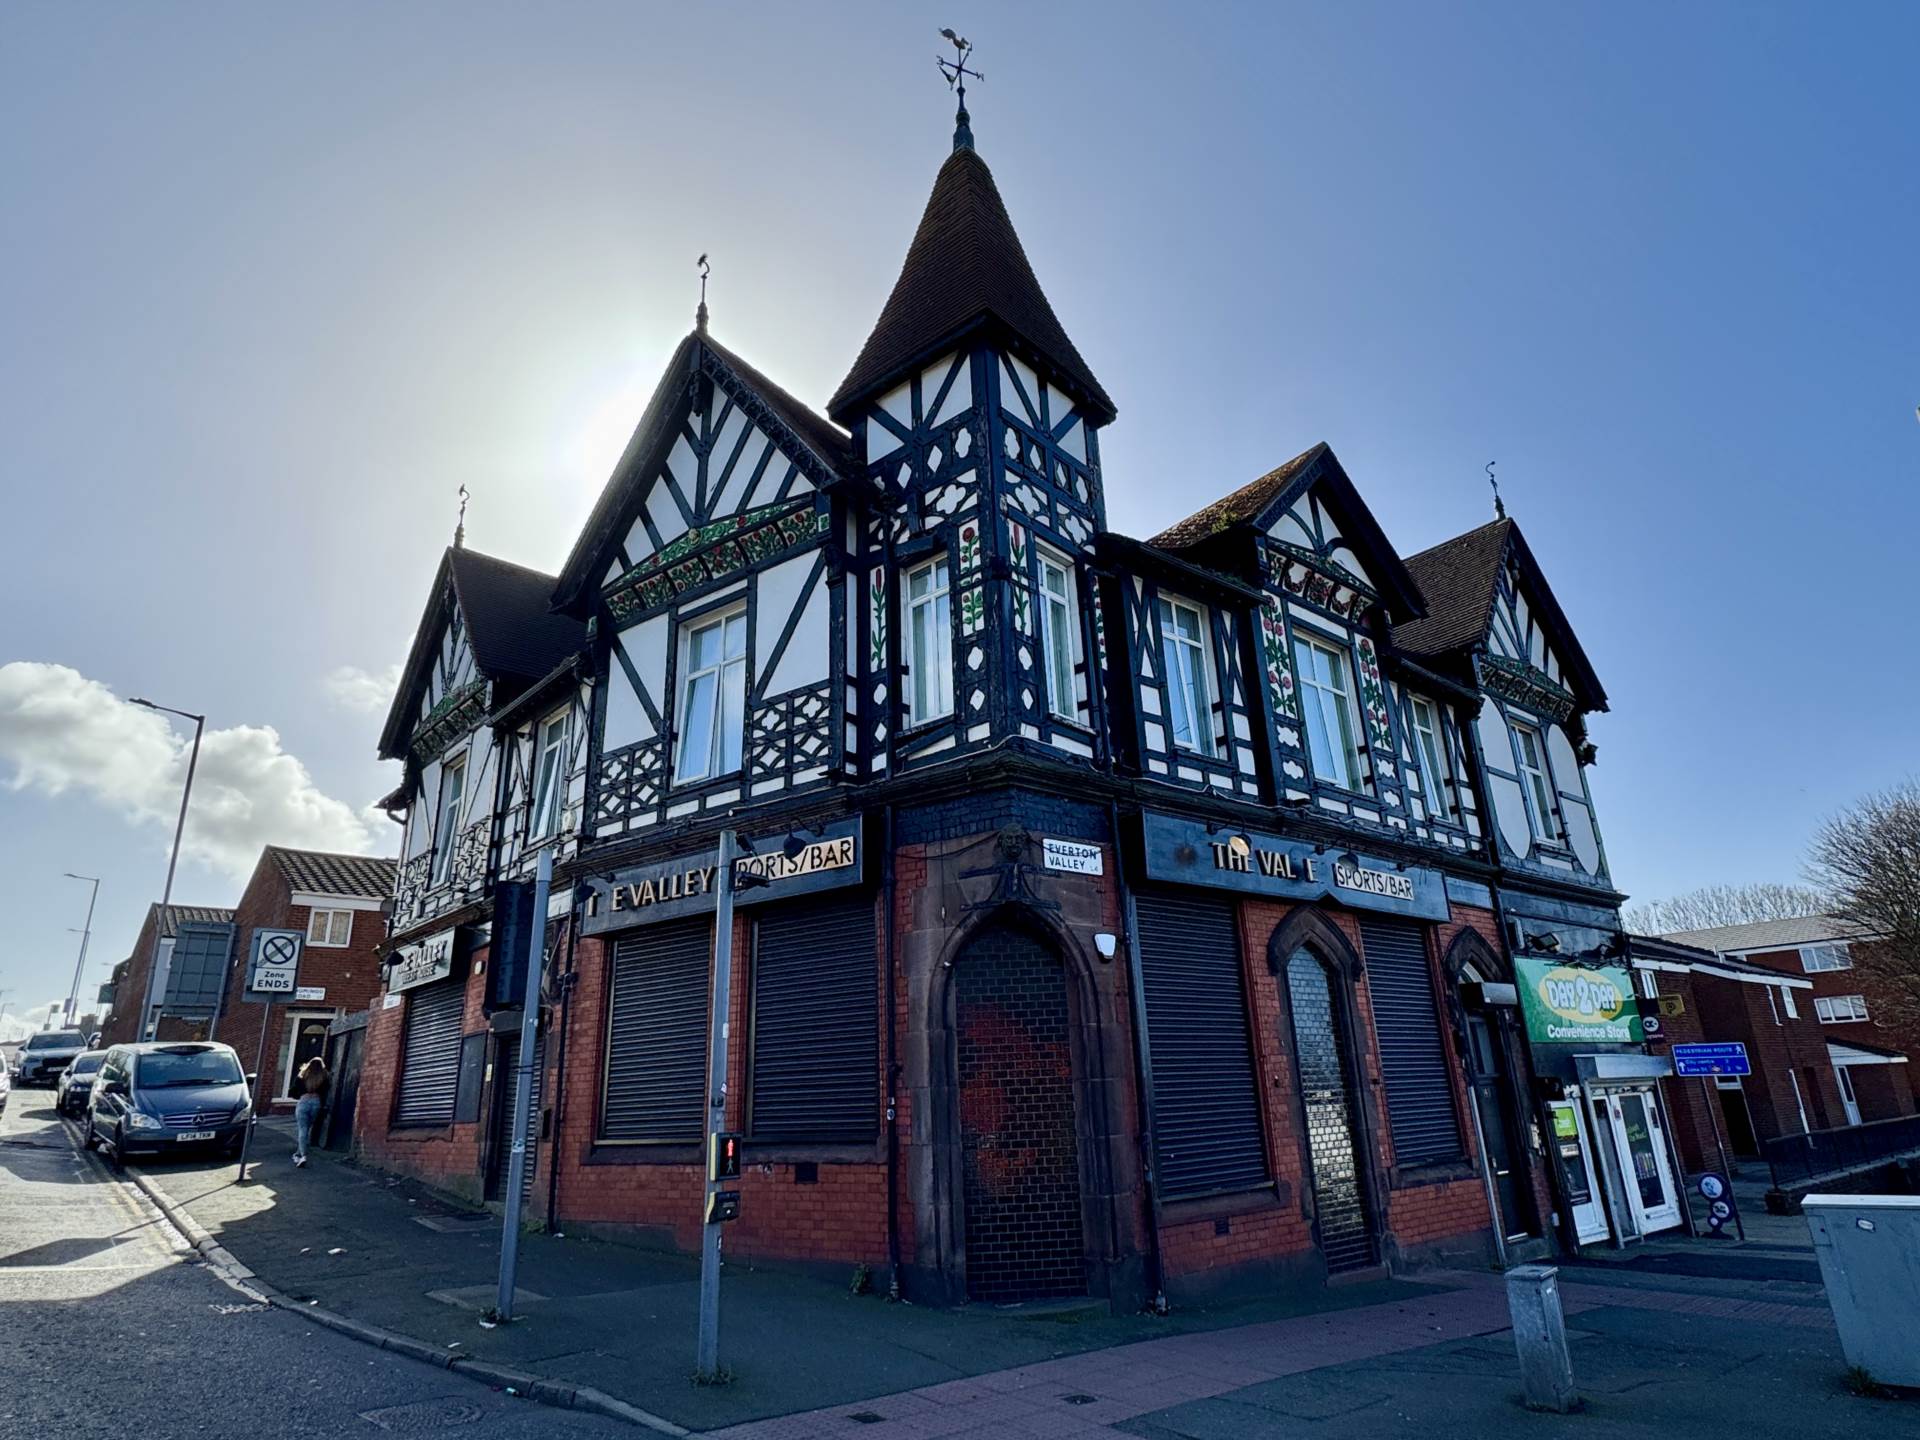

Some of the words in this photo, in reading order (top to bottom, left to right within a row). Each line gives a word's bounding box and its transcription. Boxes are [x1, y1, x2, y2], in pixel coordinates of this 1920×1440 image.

[1048, 844, 1097, 860] EVERTON
[1049, 856, 1085, 870] VALLEY
[629, 866, 716, 907] VALLEY
[737, 840, 852, 881] PORTS/BAR
[1336, 865, 1413, 898] SPORTS/BAR
[257, 979, 290, 988] ENDS
[1547, 1024, 1606, 1039] Convenience
[1606, 1025, 1631, 1039] Store
